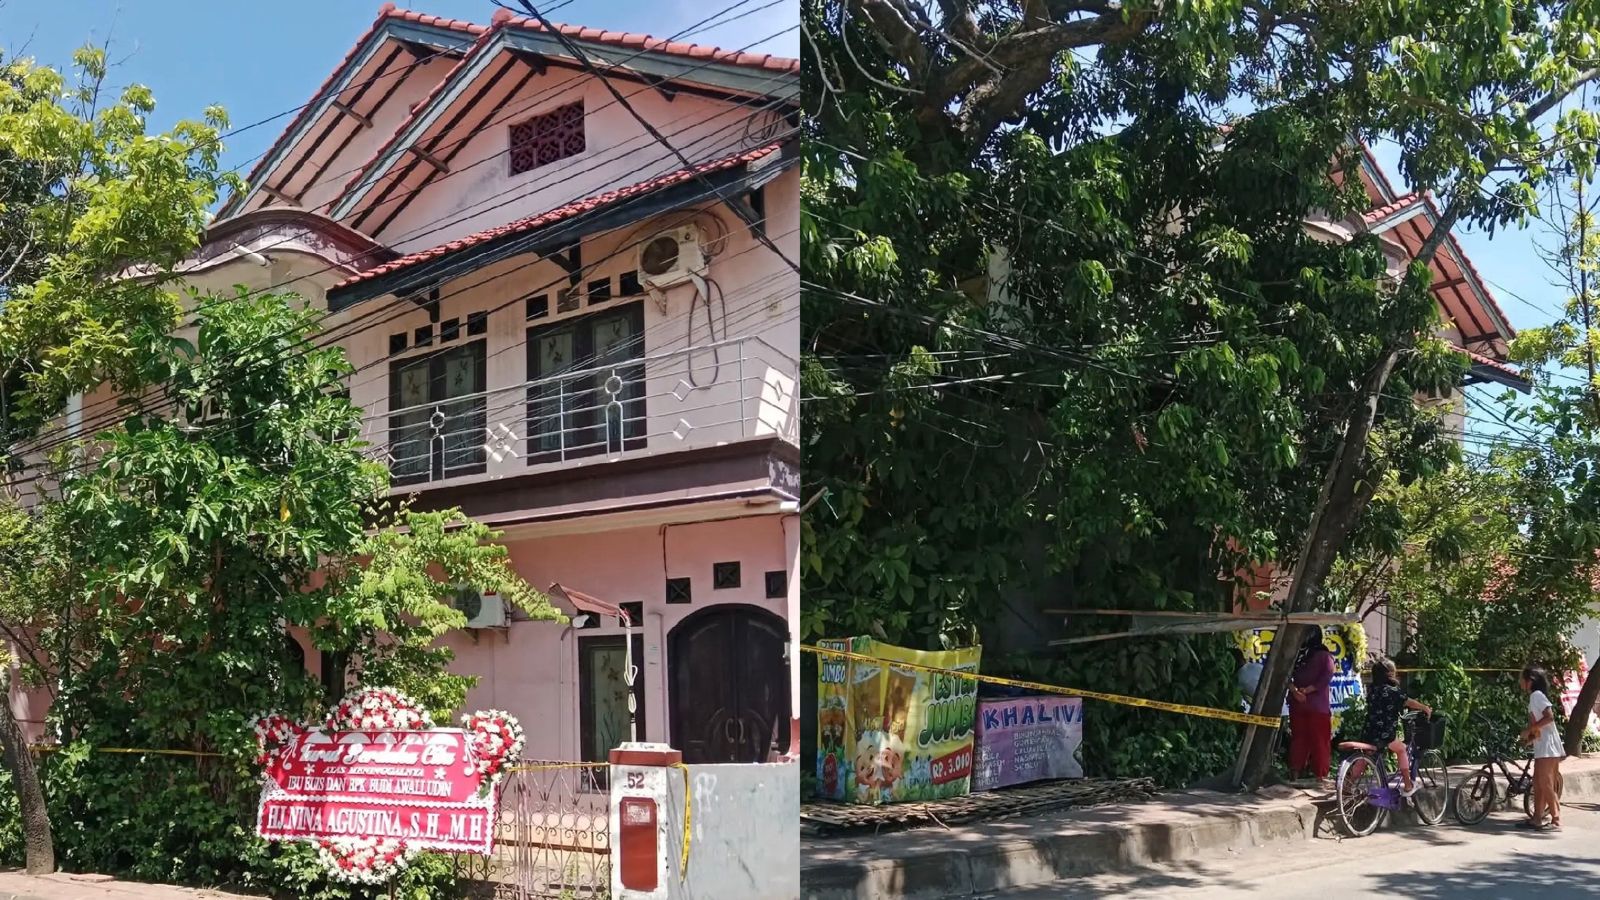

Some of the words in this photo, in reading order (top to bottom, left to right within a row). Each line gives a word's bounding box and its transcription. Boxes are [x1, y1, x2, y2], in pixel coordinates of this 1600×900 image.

[821, 662, 846, 684] JUMBO
[918, 694, 975, 748] JUMB
[299, 743, 345, 762] Turut
[322, 766, 347, 774] ATAS
[627, 771, 645, 789] 52
[287, 775, 304, 790] IBU
[325, 776, 347, 792] DAN
[348, 777, 367, 793] BPK
[394, 780, 453, 797] AWALLUDIN
